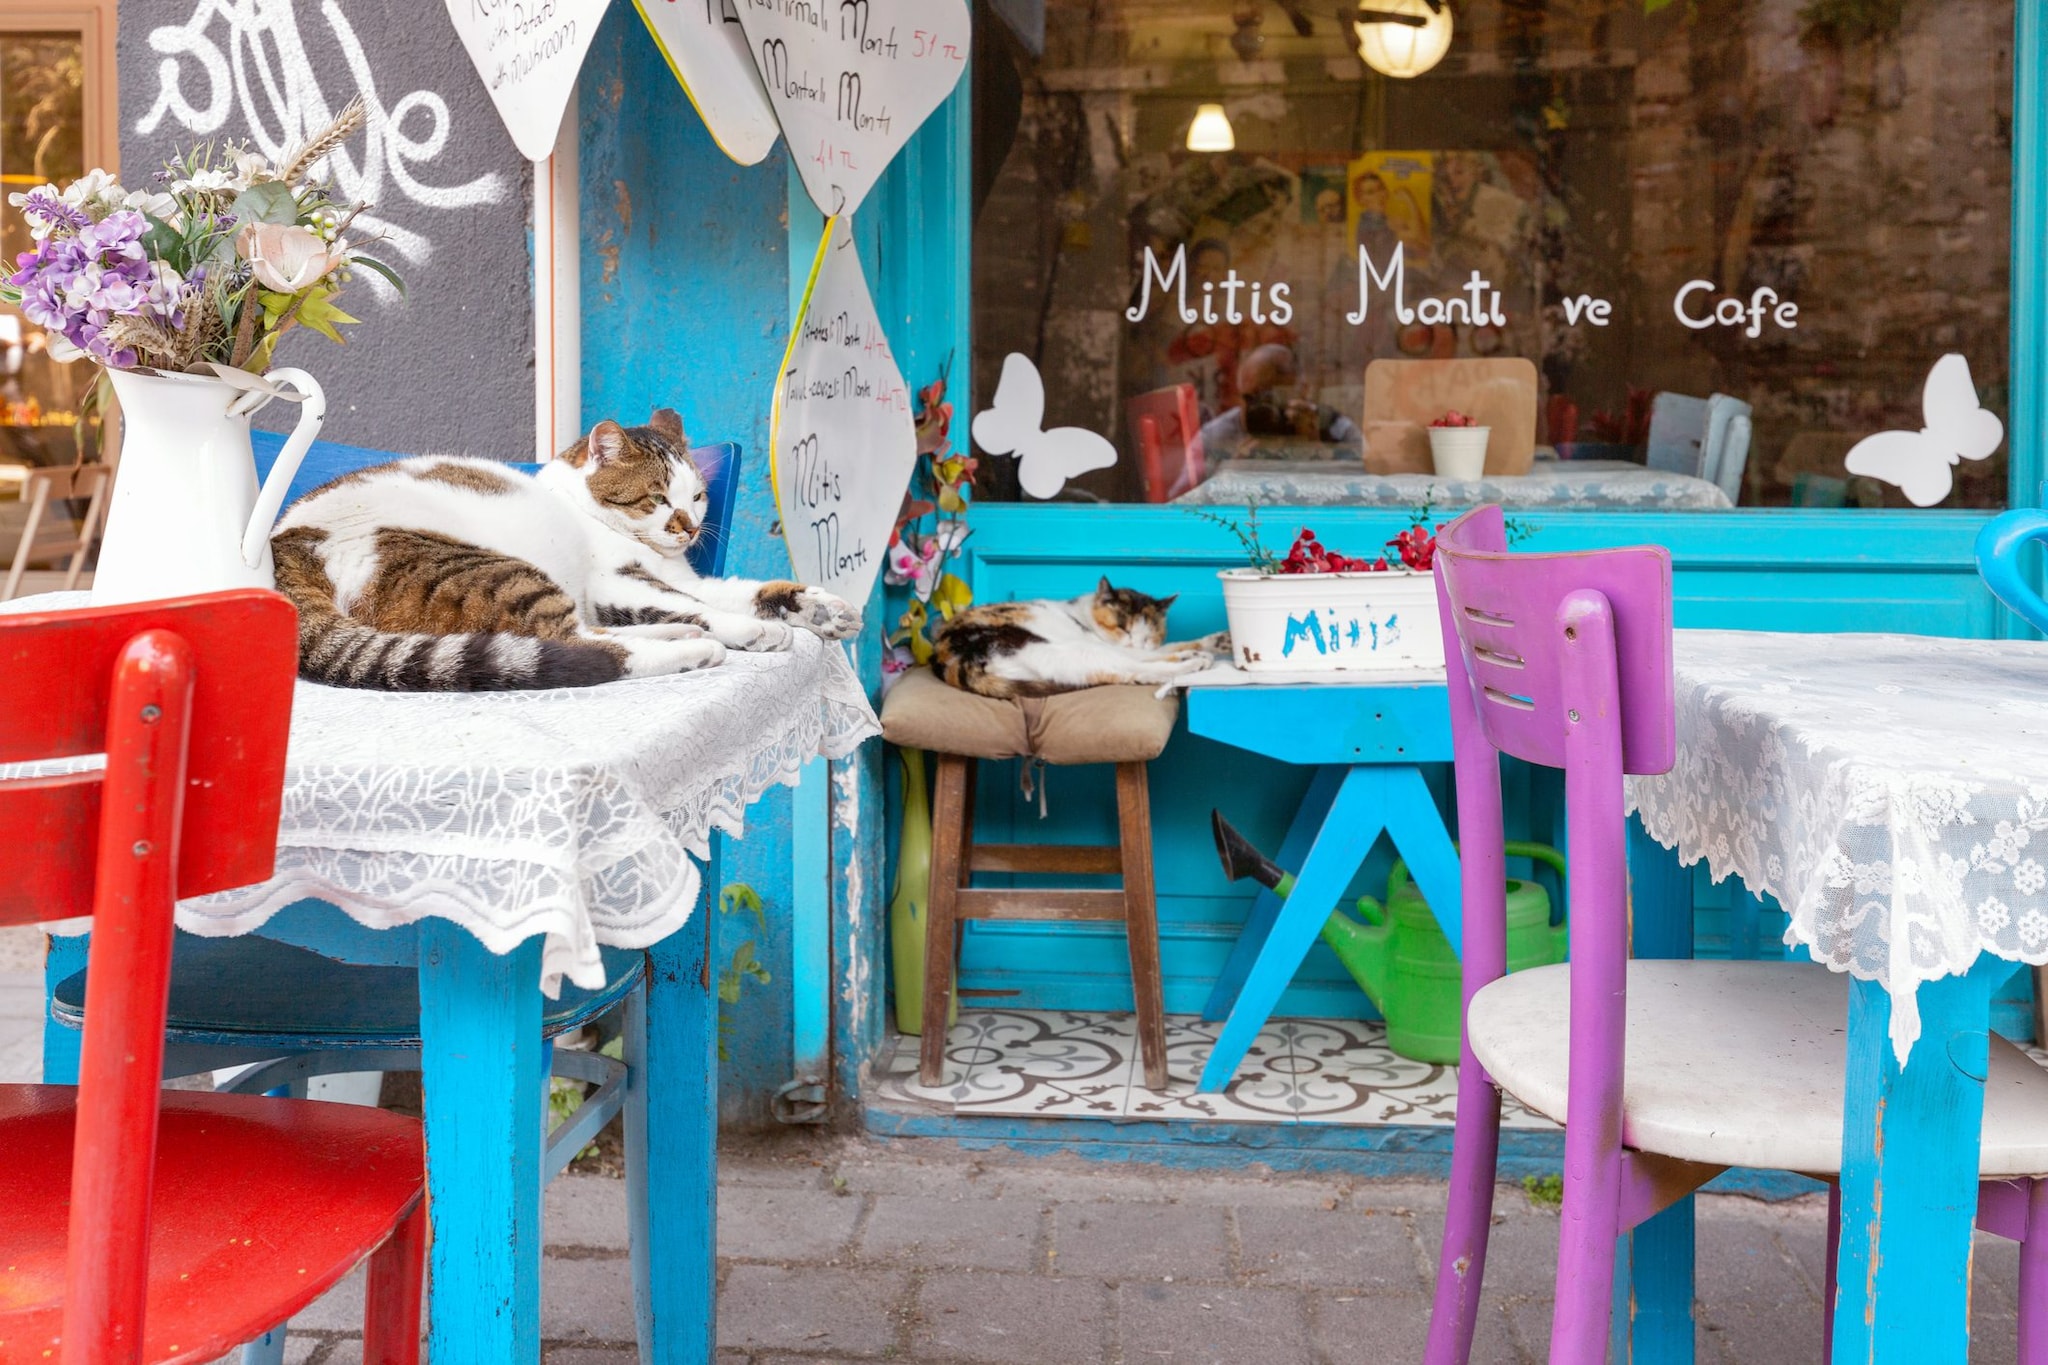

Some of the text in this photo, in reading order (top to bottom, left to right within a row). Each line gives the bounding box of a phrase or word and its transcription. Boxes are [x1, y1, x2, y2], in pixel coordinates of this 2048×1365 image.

[1125, 243, 1294, 326] Mitis
[1561, 294, 1612, 326] ve
[1673, 279, 1799, 339] Cafe
[792, 433, 841, 511] Mitis
